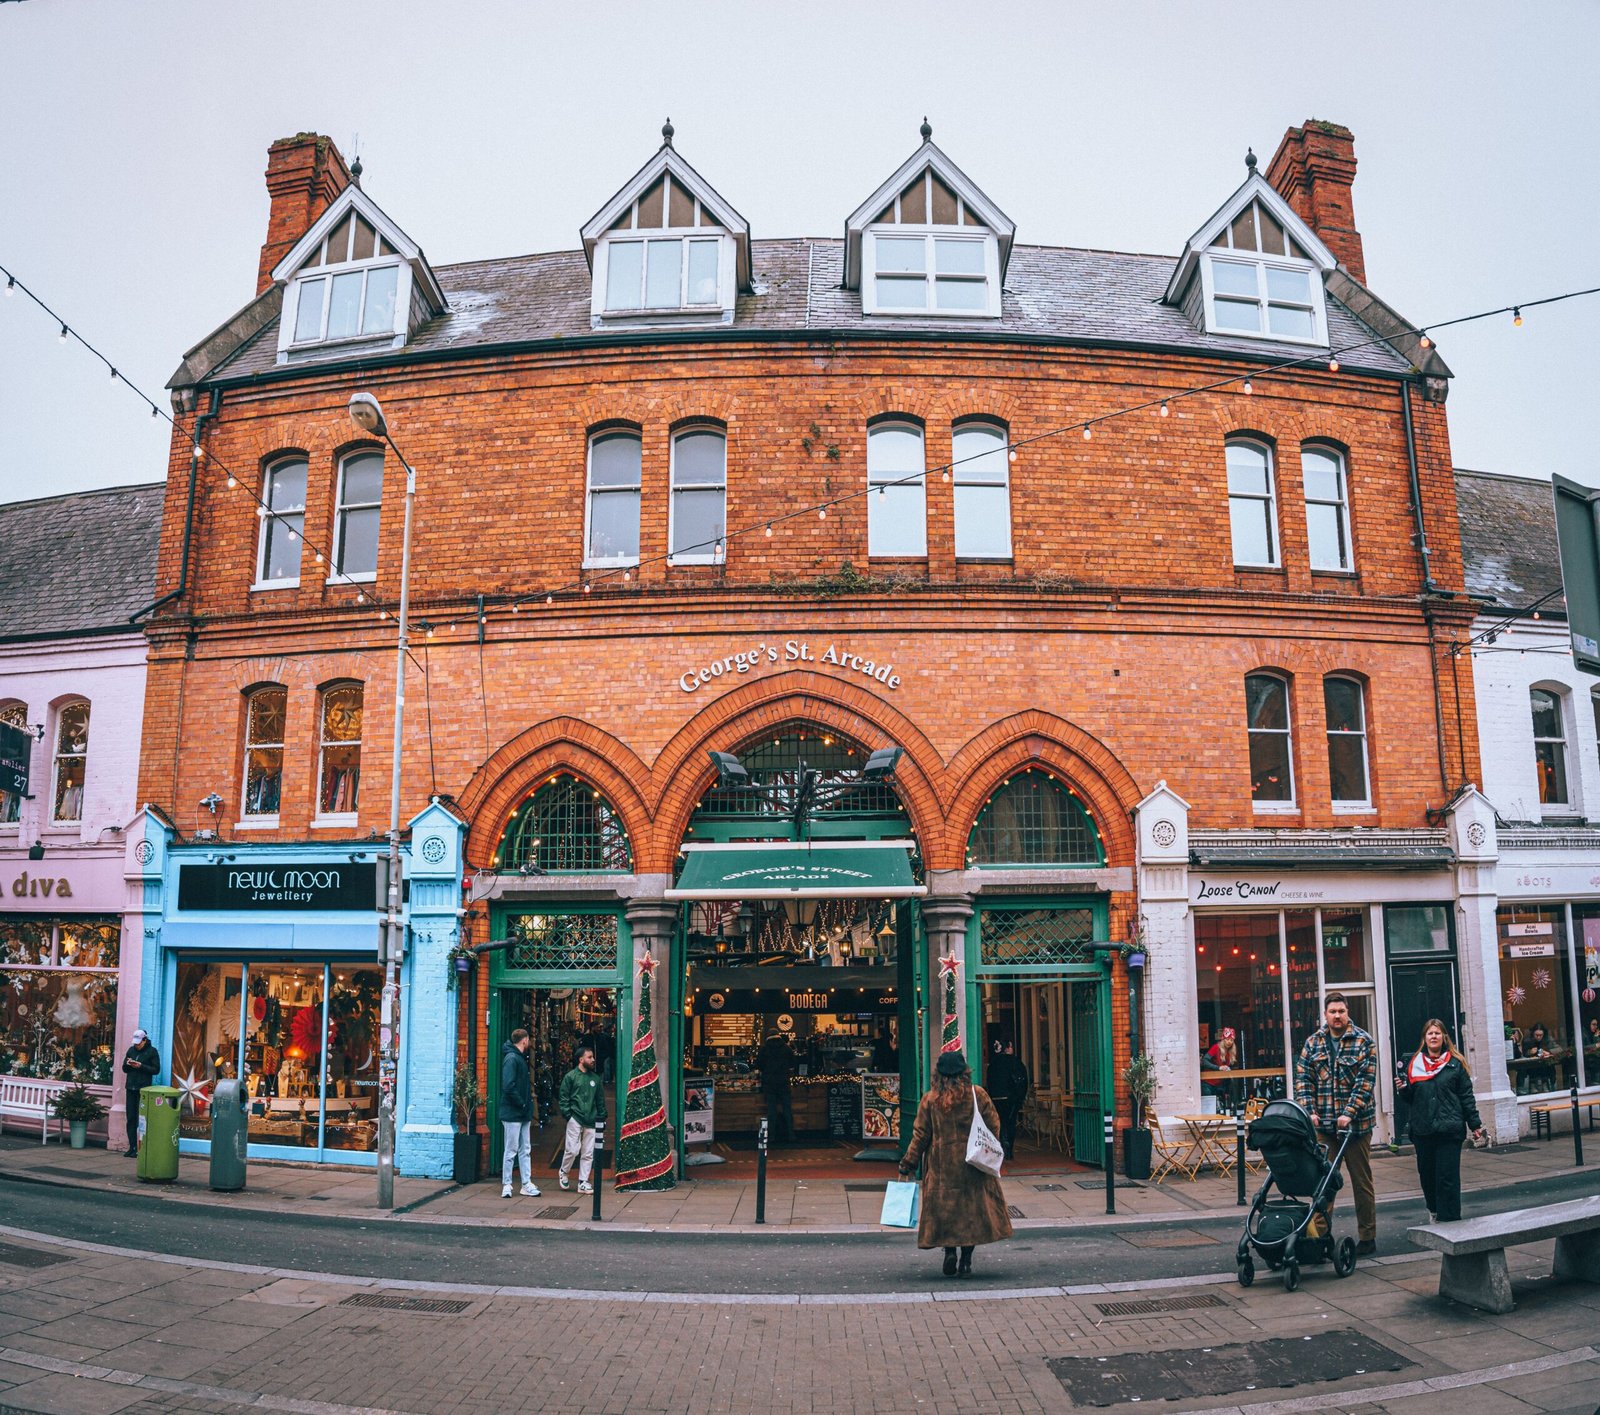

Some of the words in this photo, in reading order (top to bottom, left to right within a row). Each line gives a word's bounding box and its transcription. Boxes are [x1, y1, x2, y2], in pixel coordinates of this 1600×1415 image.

[680, 643, 778, 693] George's
[785, 640, 814, 661] St.
[820, 644, 901, 689] Arcade
[14, 774, 27, 792] 27
[228, 871, 269, 889] new
[283, 870, 340, 889] moon
[722, 865, 805, 881] GEORGE'S
[810, 866, 872, 879] STREET
[12, 870, 73, 898] diva
[252, 890, 313, 903] Jewellery
[789, 993, 828, 1009] BODEGA
